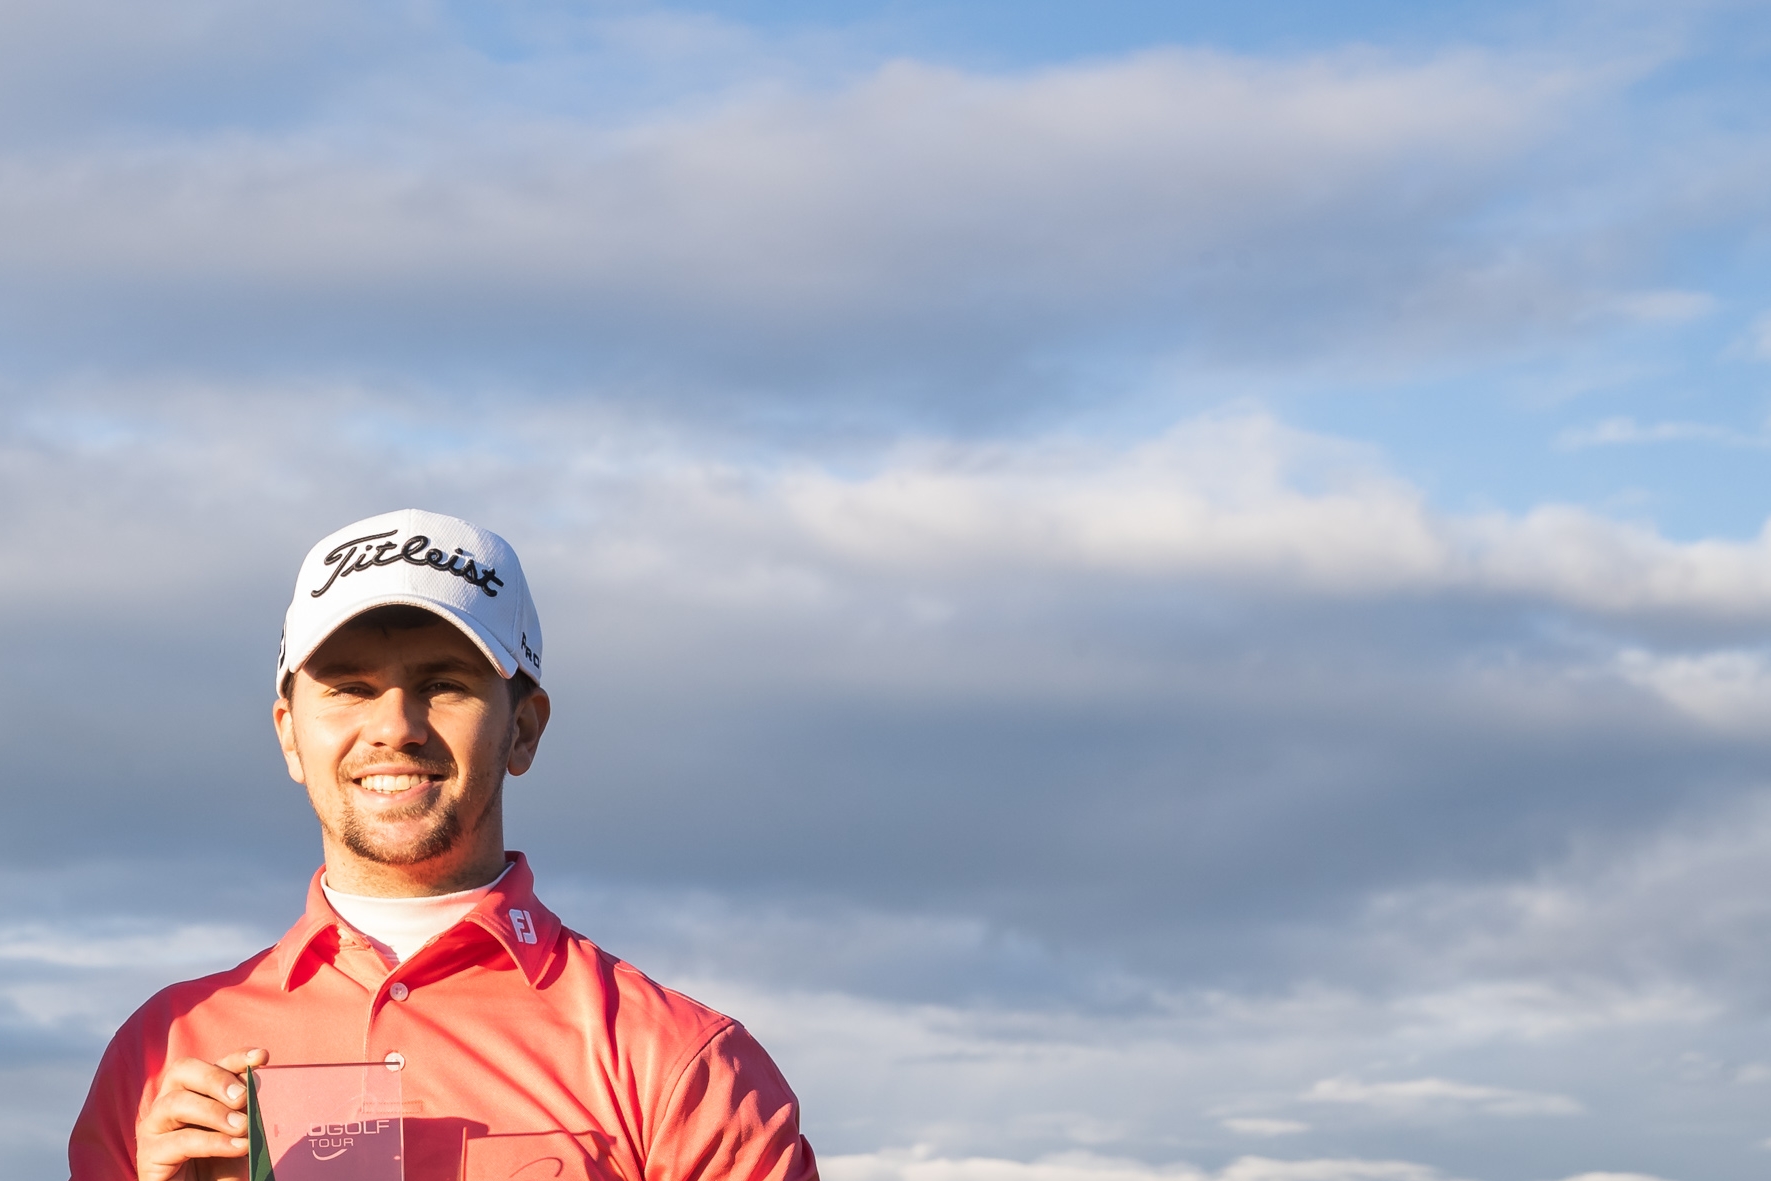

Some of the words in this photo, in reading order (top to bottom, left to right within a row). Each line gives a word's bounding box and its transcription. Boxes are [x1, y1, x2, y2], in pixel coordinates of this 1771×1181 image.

[311, 529, 504, 598] Titleist
[521, 631, 540, 670] PRO
[509, 908, 538, 945] FJ
[309, 1137, 354, 1148] TOUR
